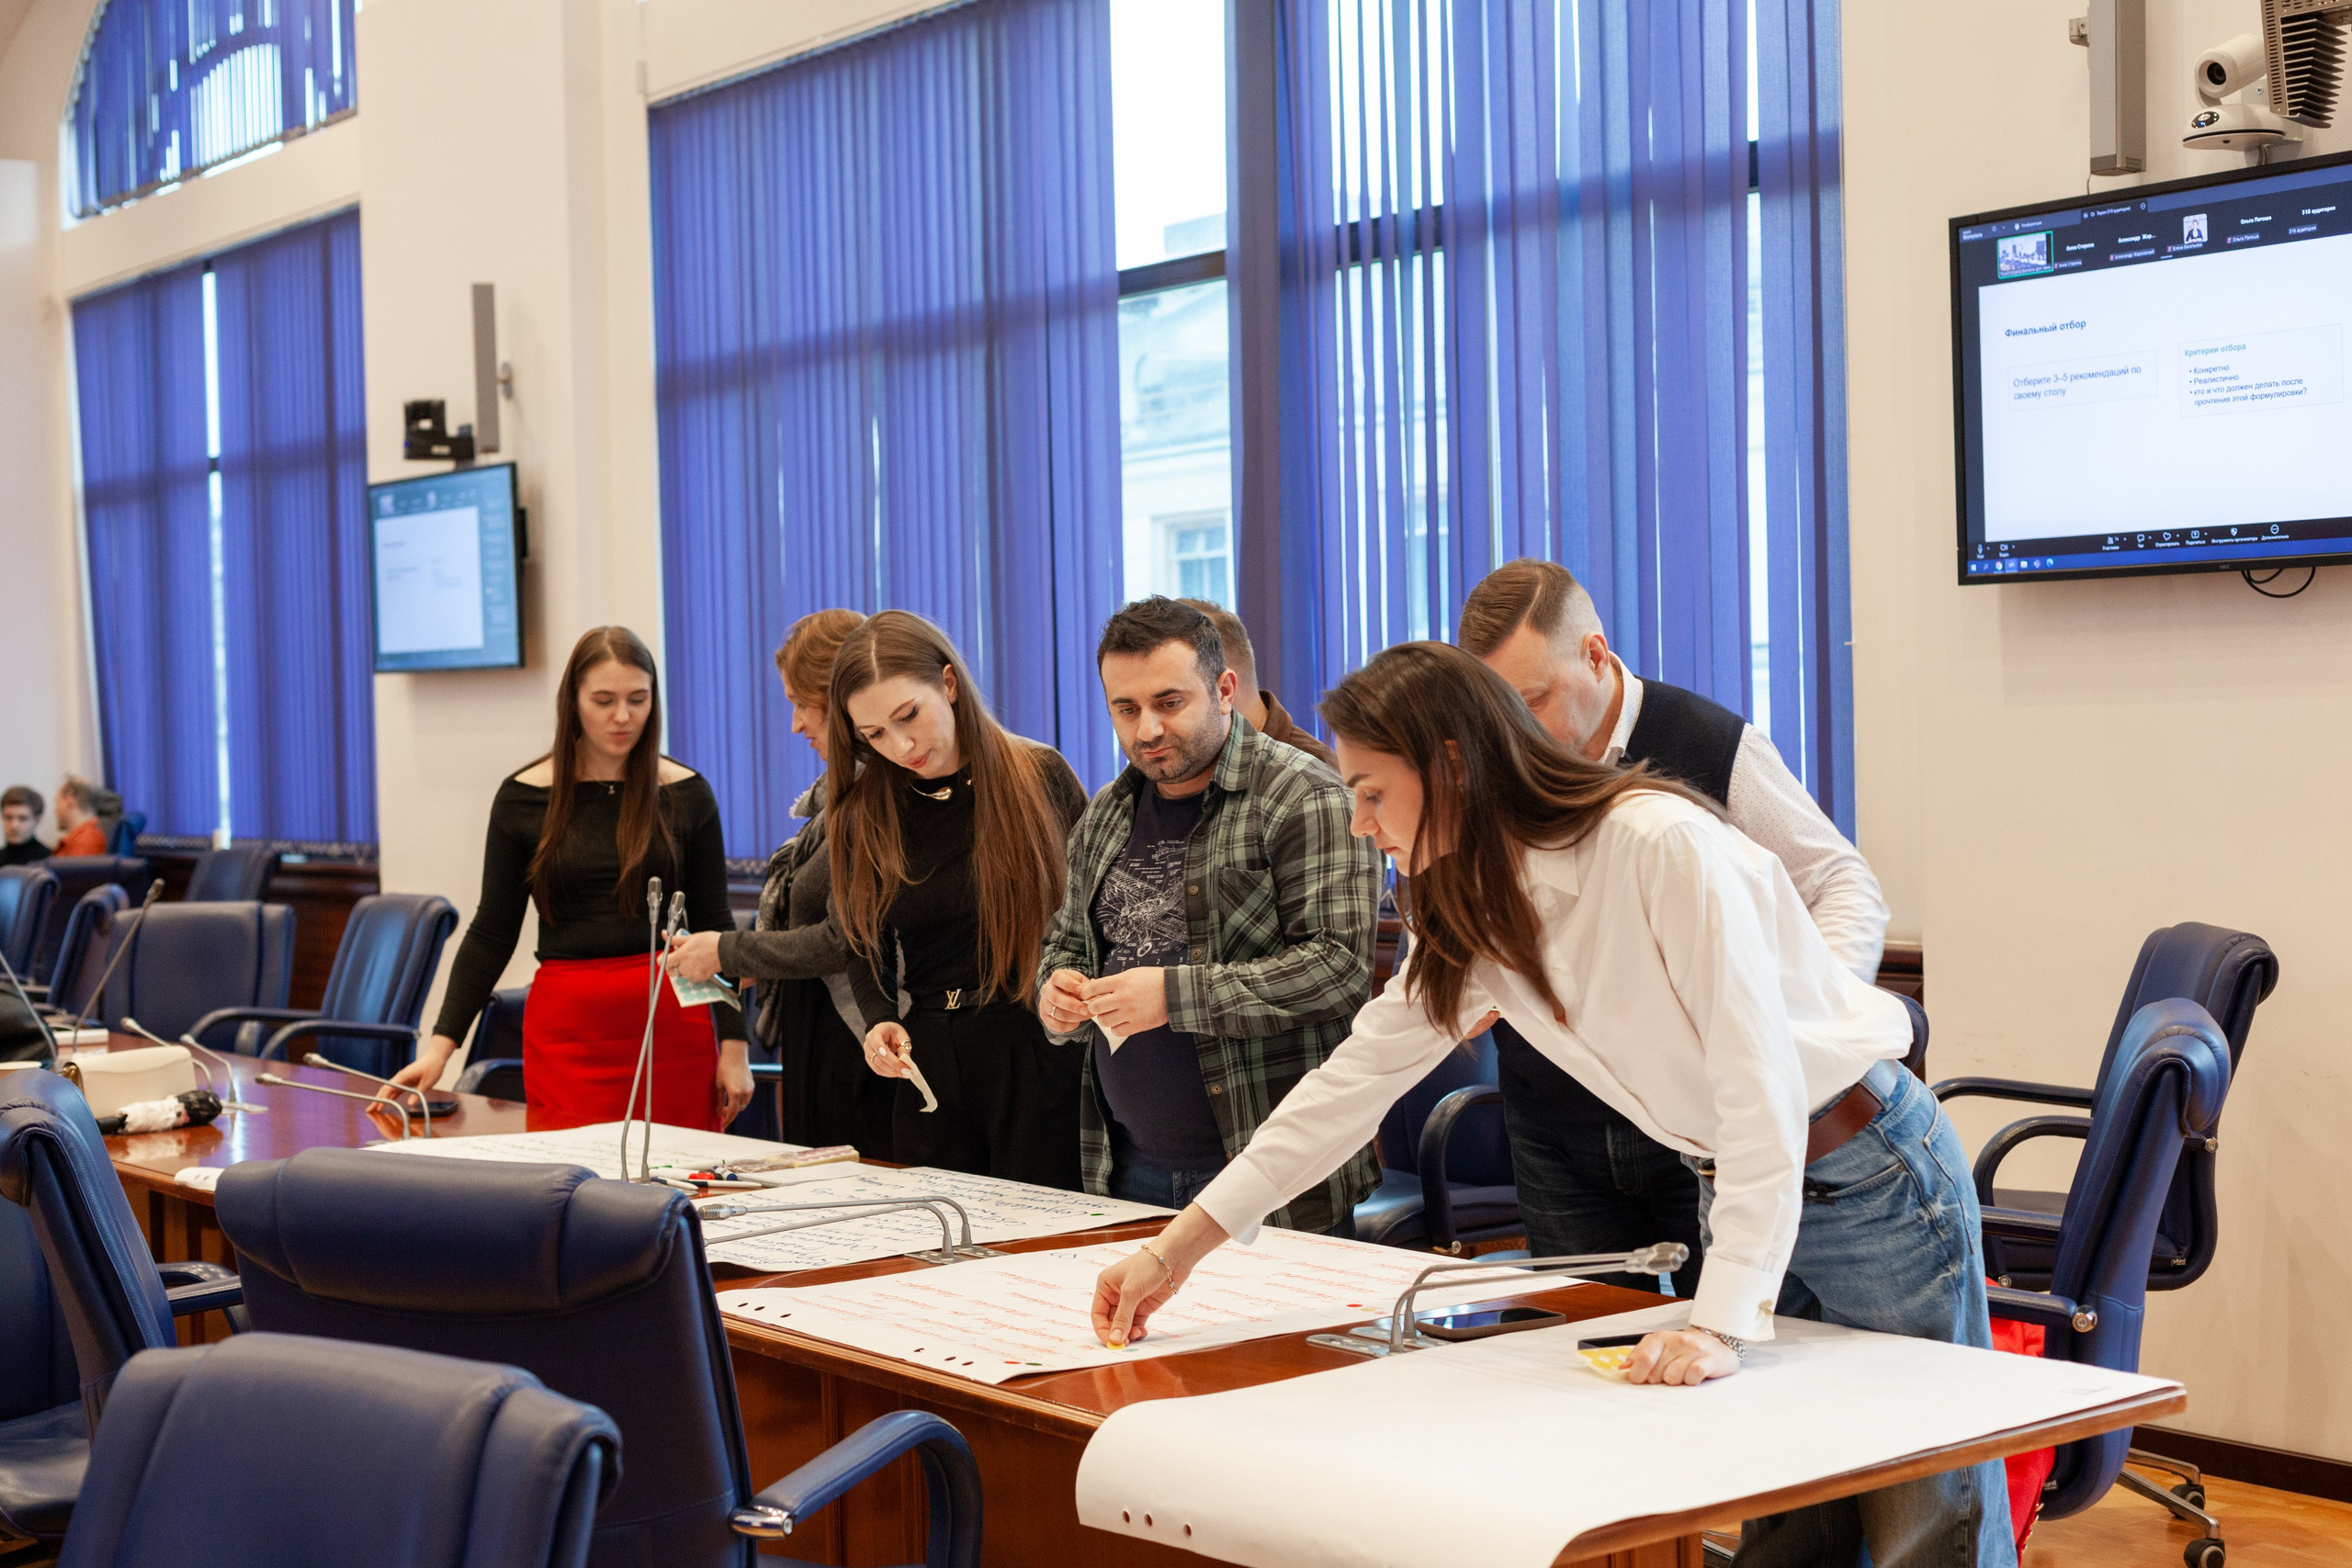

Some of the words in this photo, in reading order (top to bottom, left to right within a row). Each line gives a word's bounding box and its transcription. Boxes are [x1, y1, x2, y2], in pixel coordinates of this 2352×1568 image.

[2005, 322, 2057, 337] Финальный
[2060, 320, 2086, 331] отбор
[2184, 347, 2219, 358] Критерии
[2220, 344, 2246, 353] отбора
[2013, 376, 2052, 388] Отберите
[2069, 366, 2130, 384] рекомендаций
[2131, 366, 2142, 375] по
[2193, 365, 2230, 375] Конкретно
[2193, 374, 2239, 385] Реалистично
[2226, 384, 2254, 393] должен
[2254, 381, 2280, 390] делать
[2281, 378, 2303, 387] после
[2013, 390, 2041, 400] своему
[2043, 387, 2066, 398] столу
[2194, 396, 2231, 407] прочтения
[2232, 393, 2248, 402] этой
[2250, 387, 2308, 401] формулировки?
